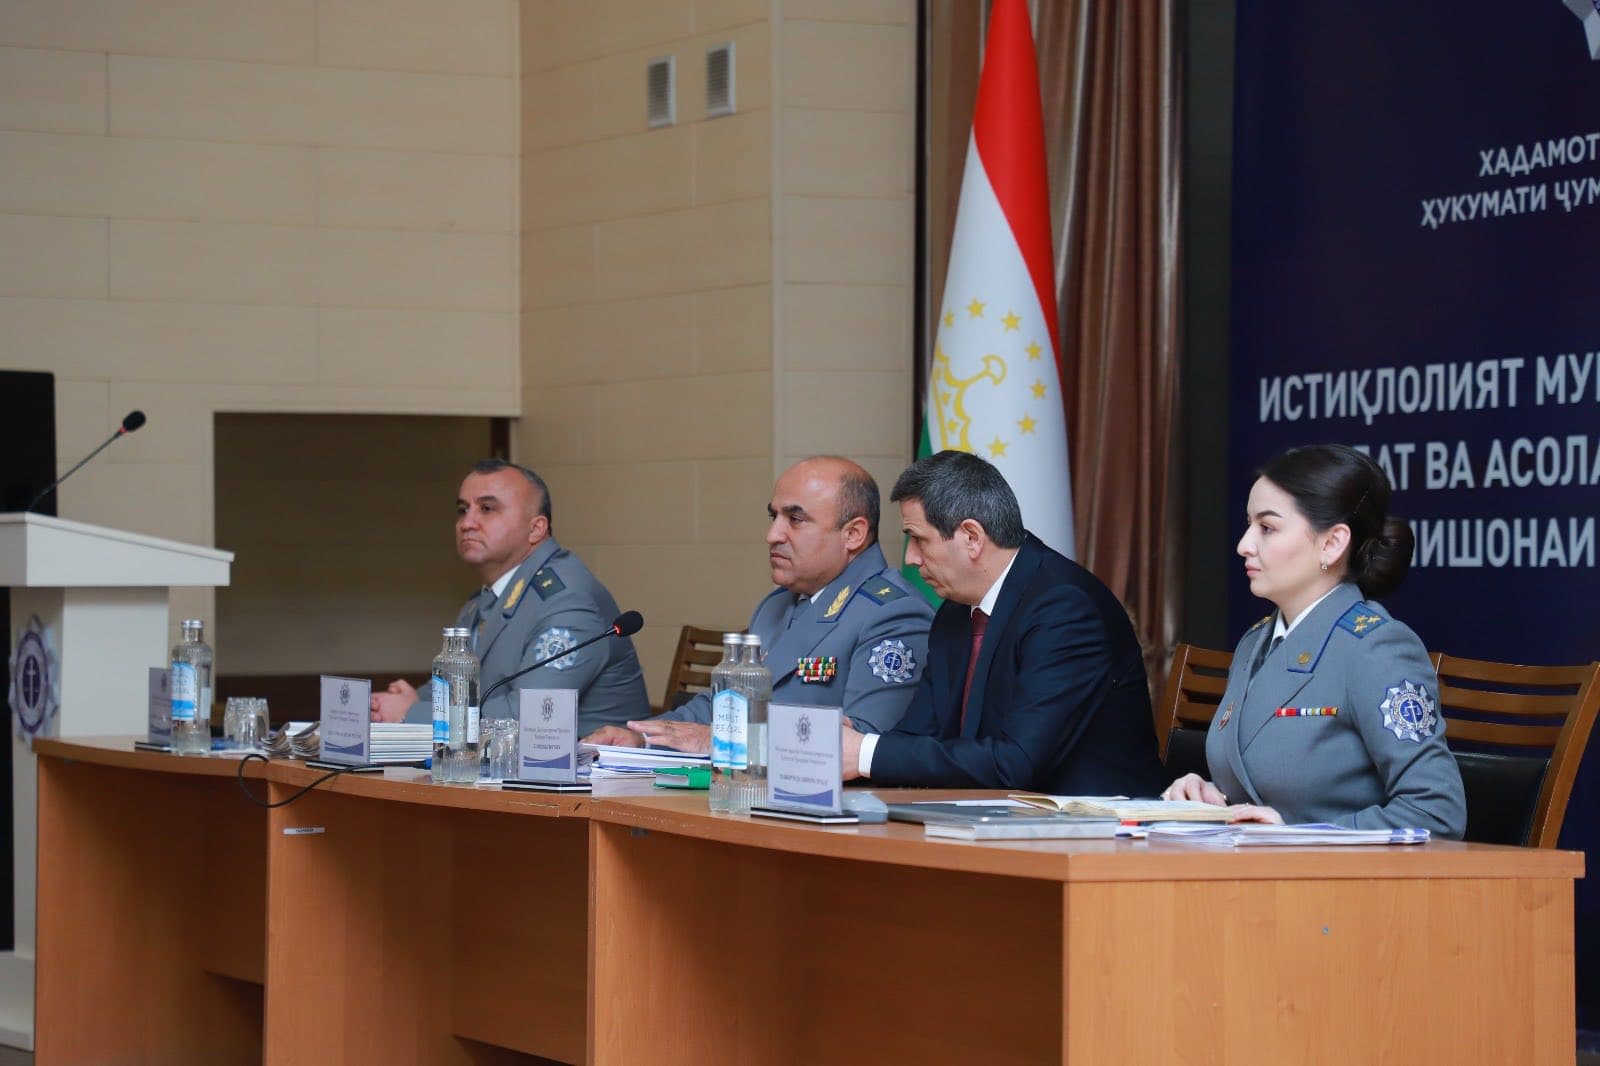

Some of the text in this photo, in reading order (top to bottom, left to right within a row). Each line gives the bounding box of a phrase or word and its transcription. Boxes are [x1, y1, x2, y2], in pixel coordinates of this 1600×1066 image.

[1479, 133, 1600, 177] ХАДАМОТ
[1421, 183, 1547, 230] ҲУКУМАТИ
[1259, 352, 1600, 425] ИСТИҚЛОЛИЯТ МУ
[1426, 441, 1475, 489] ВА
